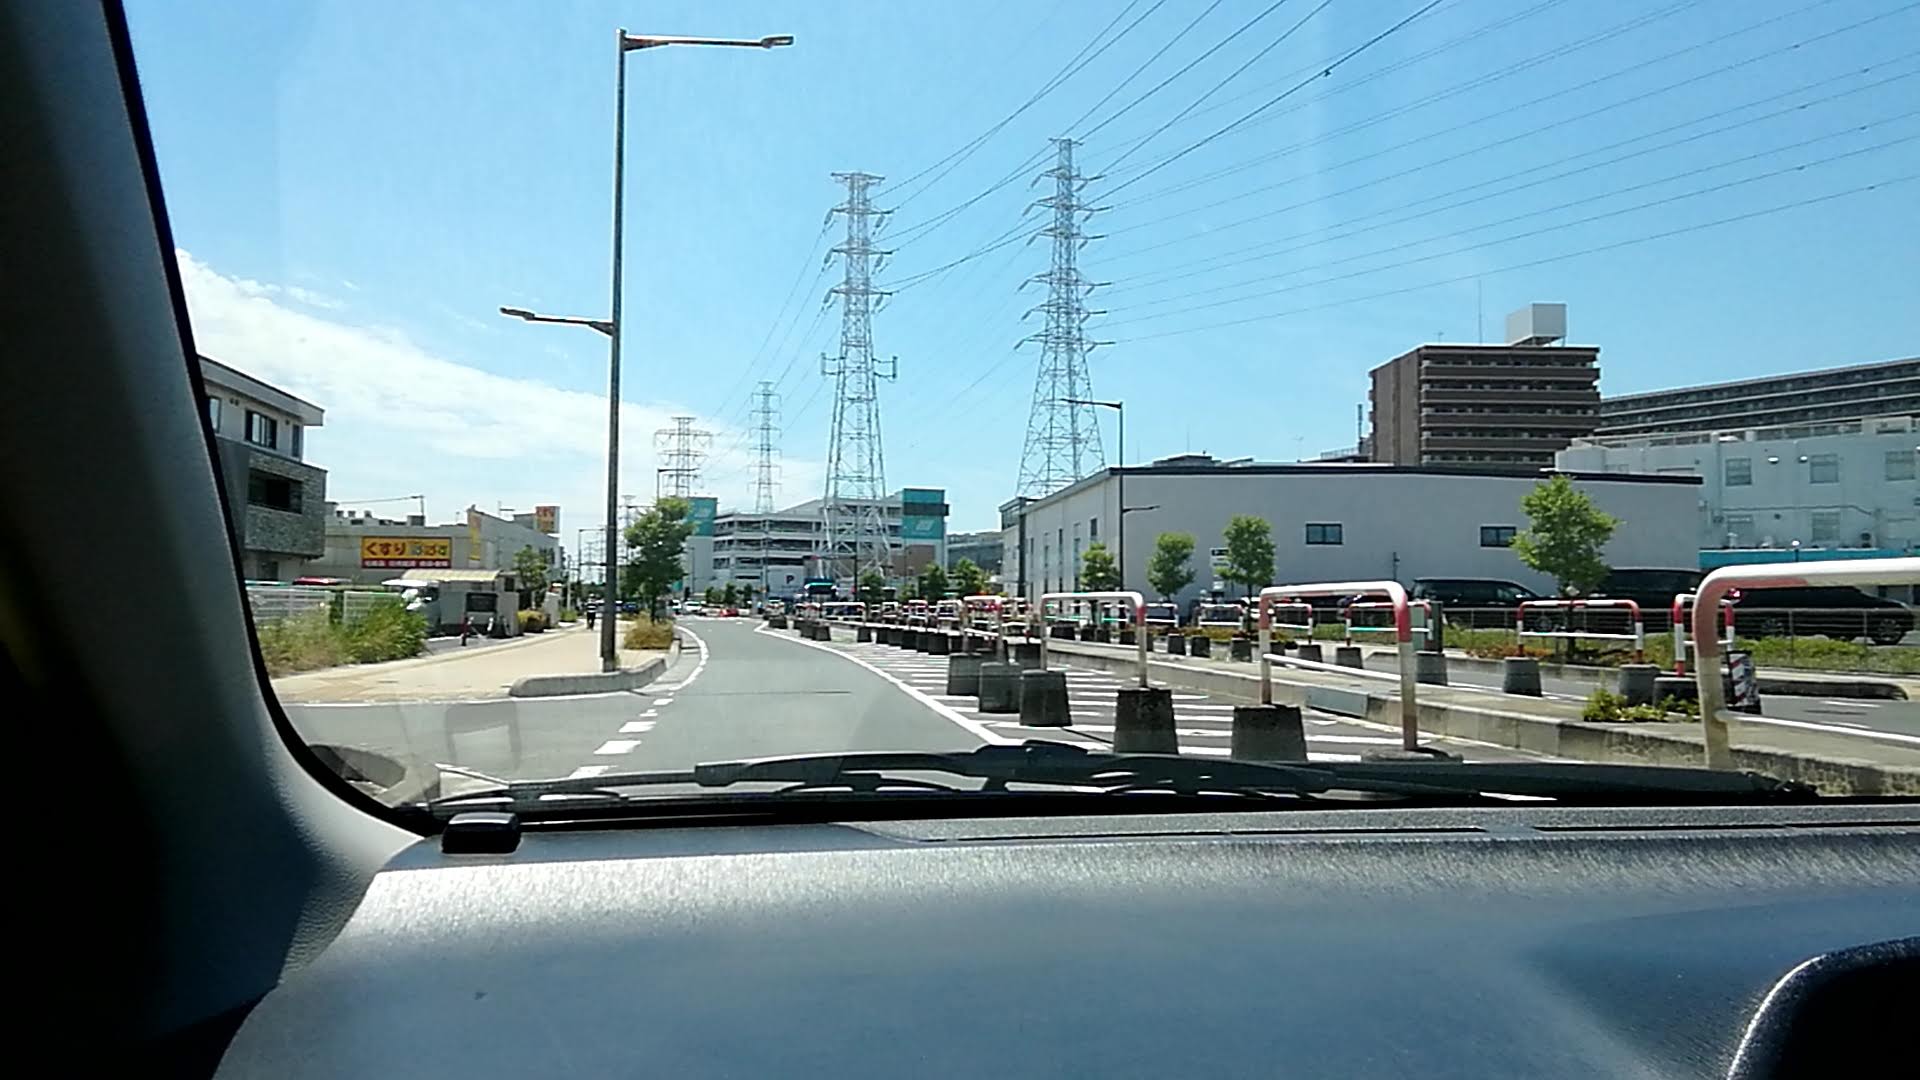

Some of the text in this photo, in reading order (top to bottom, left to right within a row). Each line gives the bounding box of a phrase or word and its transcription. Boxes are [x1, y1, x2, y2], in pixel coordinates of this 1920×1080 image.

[366, 542, 406, 556] くすり
[786, 575, 795, 585] P
